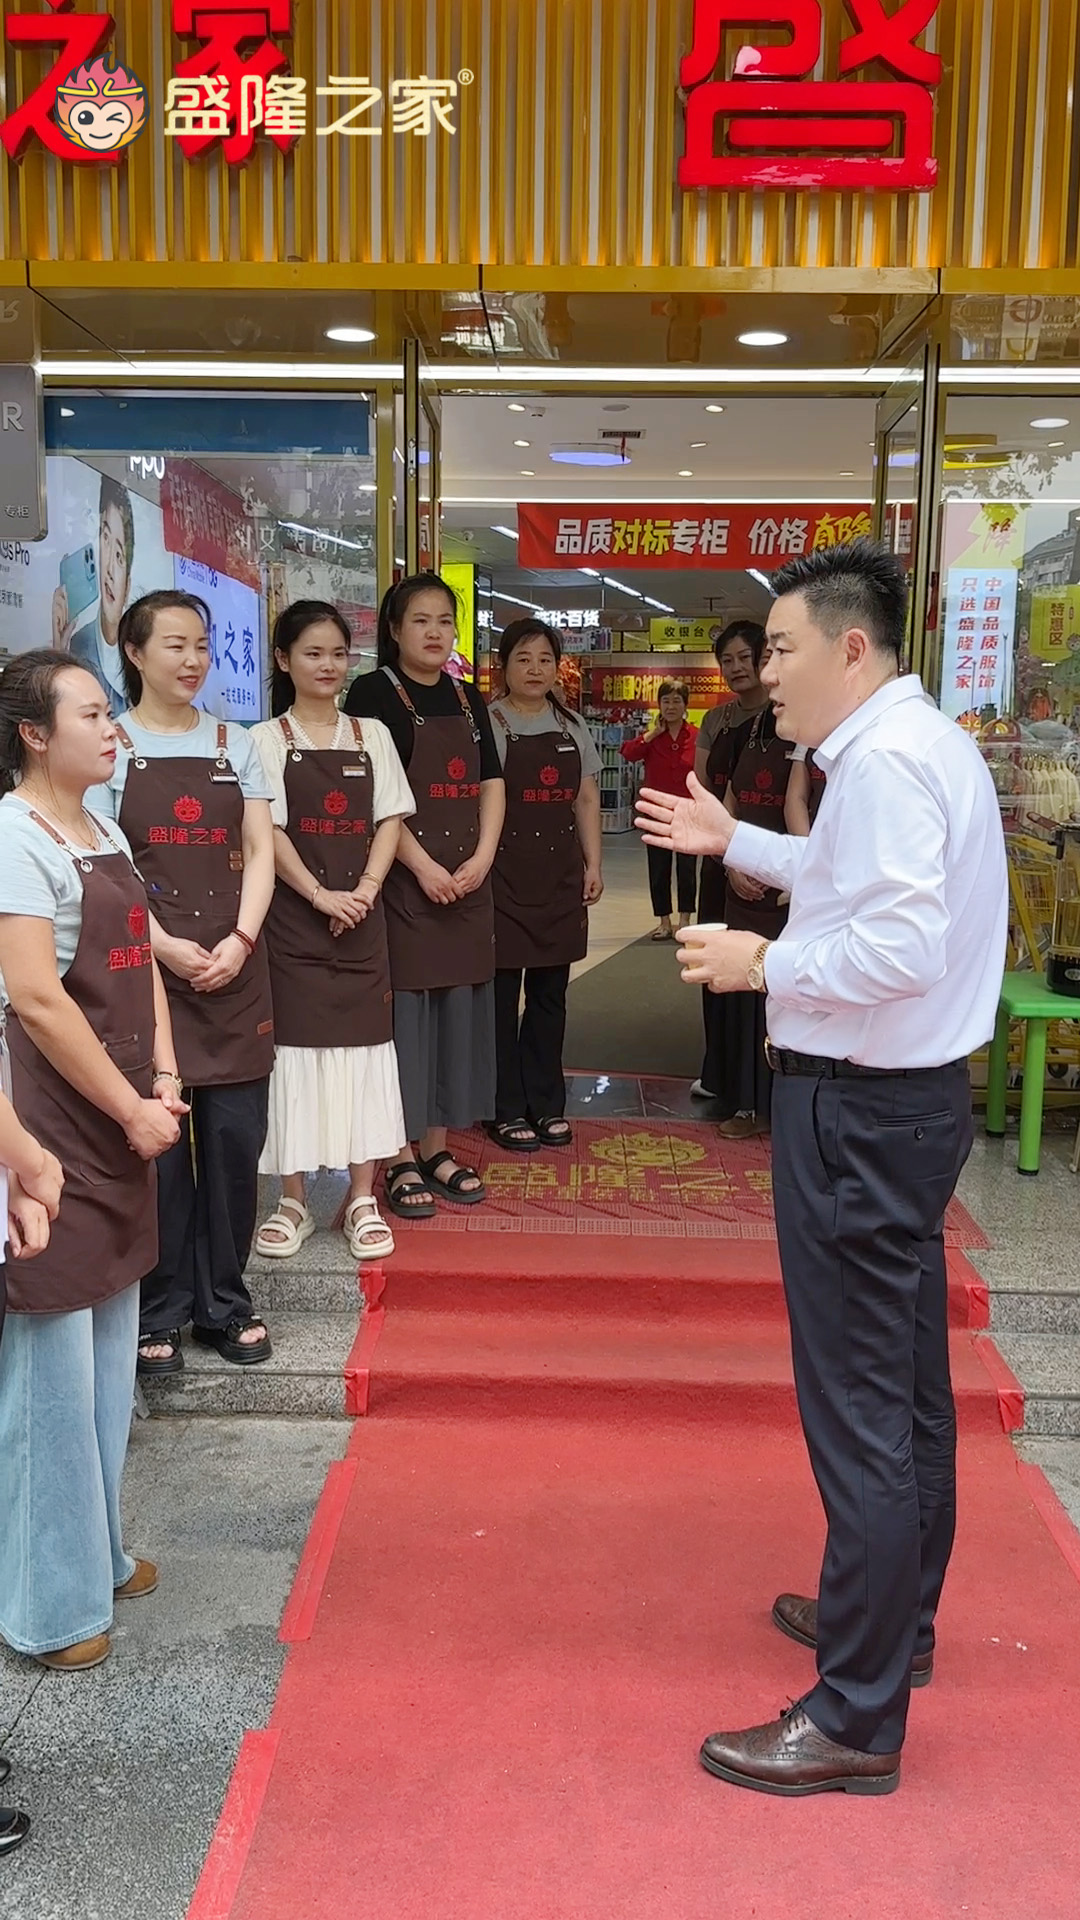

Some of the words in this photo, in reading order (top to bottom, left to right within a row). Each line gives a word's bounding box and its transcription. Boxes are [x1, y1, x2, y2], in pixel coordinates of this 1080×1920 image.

[4, 505, 29, 518] 专柜
[555, 518, 731, 555] 品质对标专柜
[15, 541, 31, 567] Pro
[664, 625, 705, 638] 收银台
[955, 577, 978, 689] 只选盛隆之家
[978, 577, 1002, 688] 中国品质服饰
[1049, 602, 1065, 645] 特惠区
[429, 783, 480, 799] 盛隆之家
[148, 826, 228, 846] 盛隆之家
[299, 817, 367, 835] 盛隆之家
